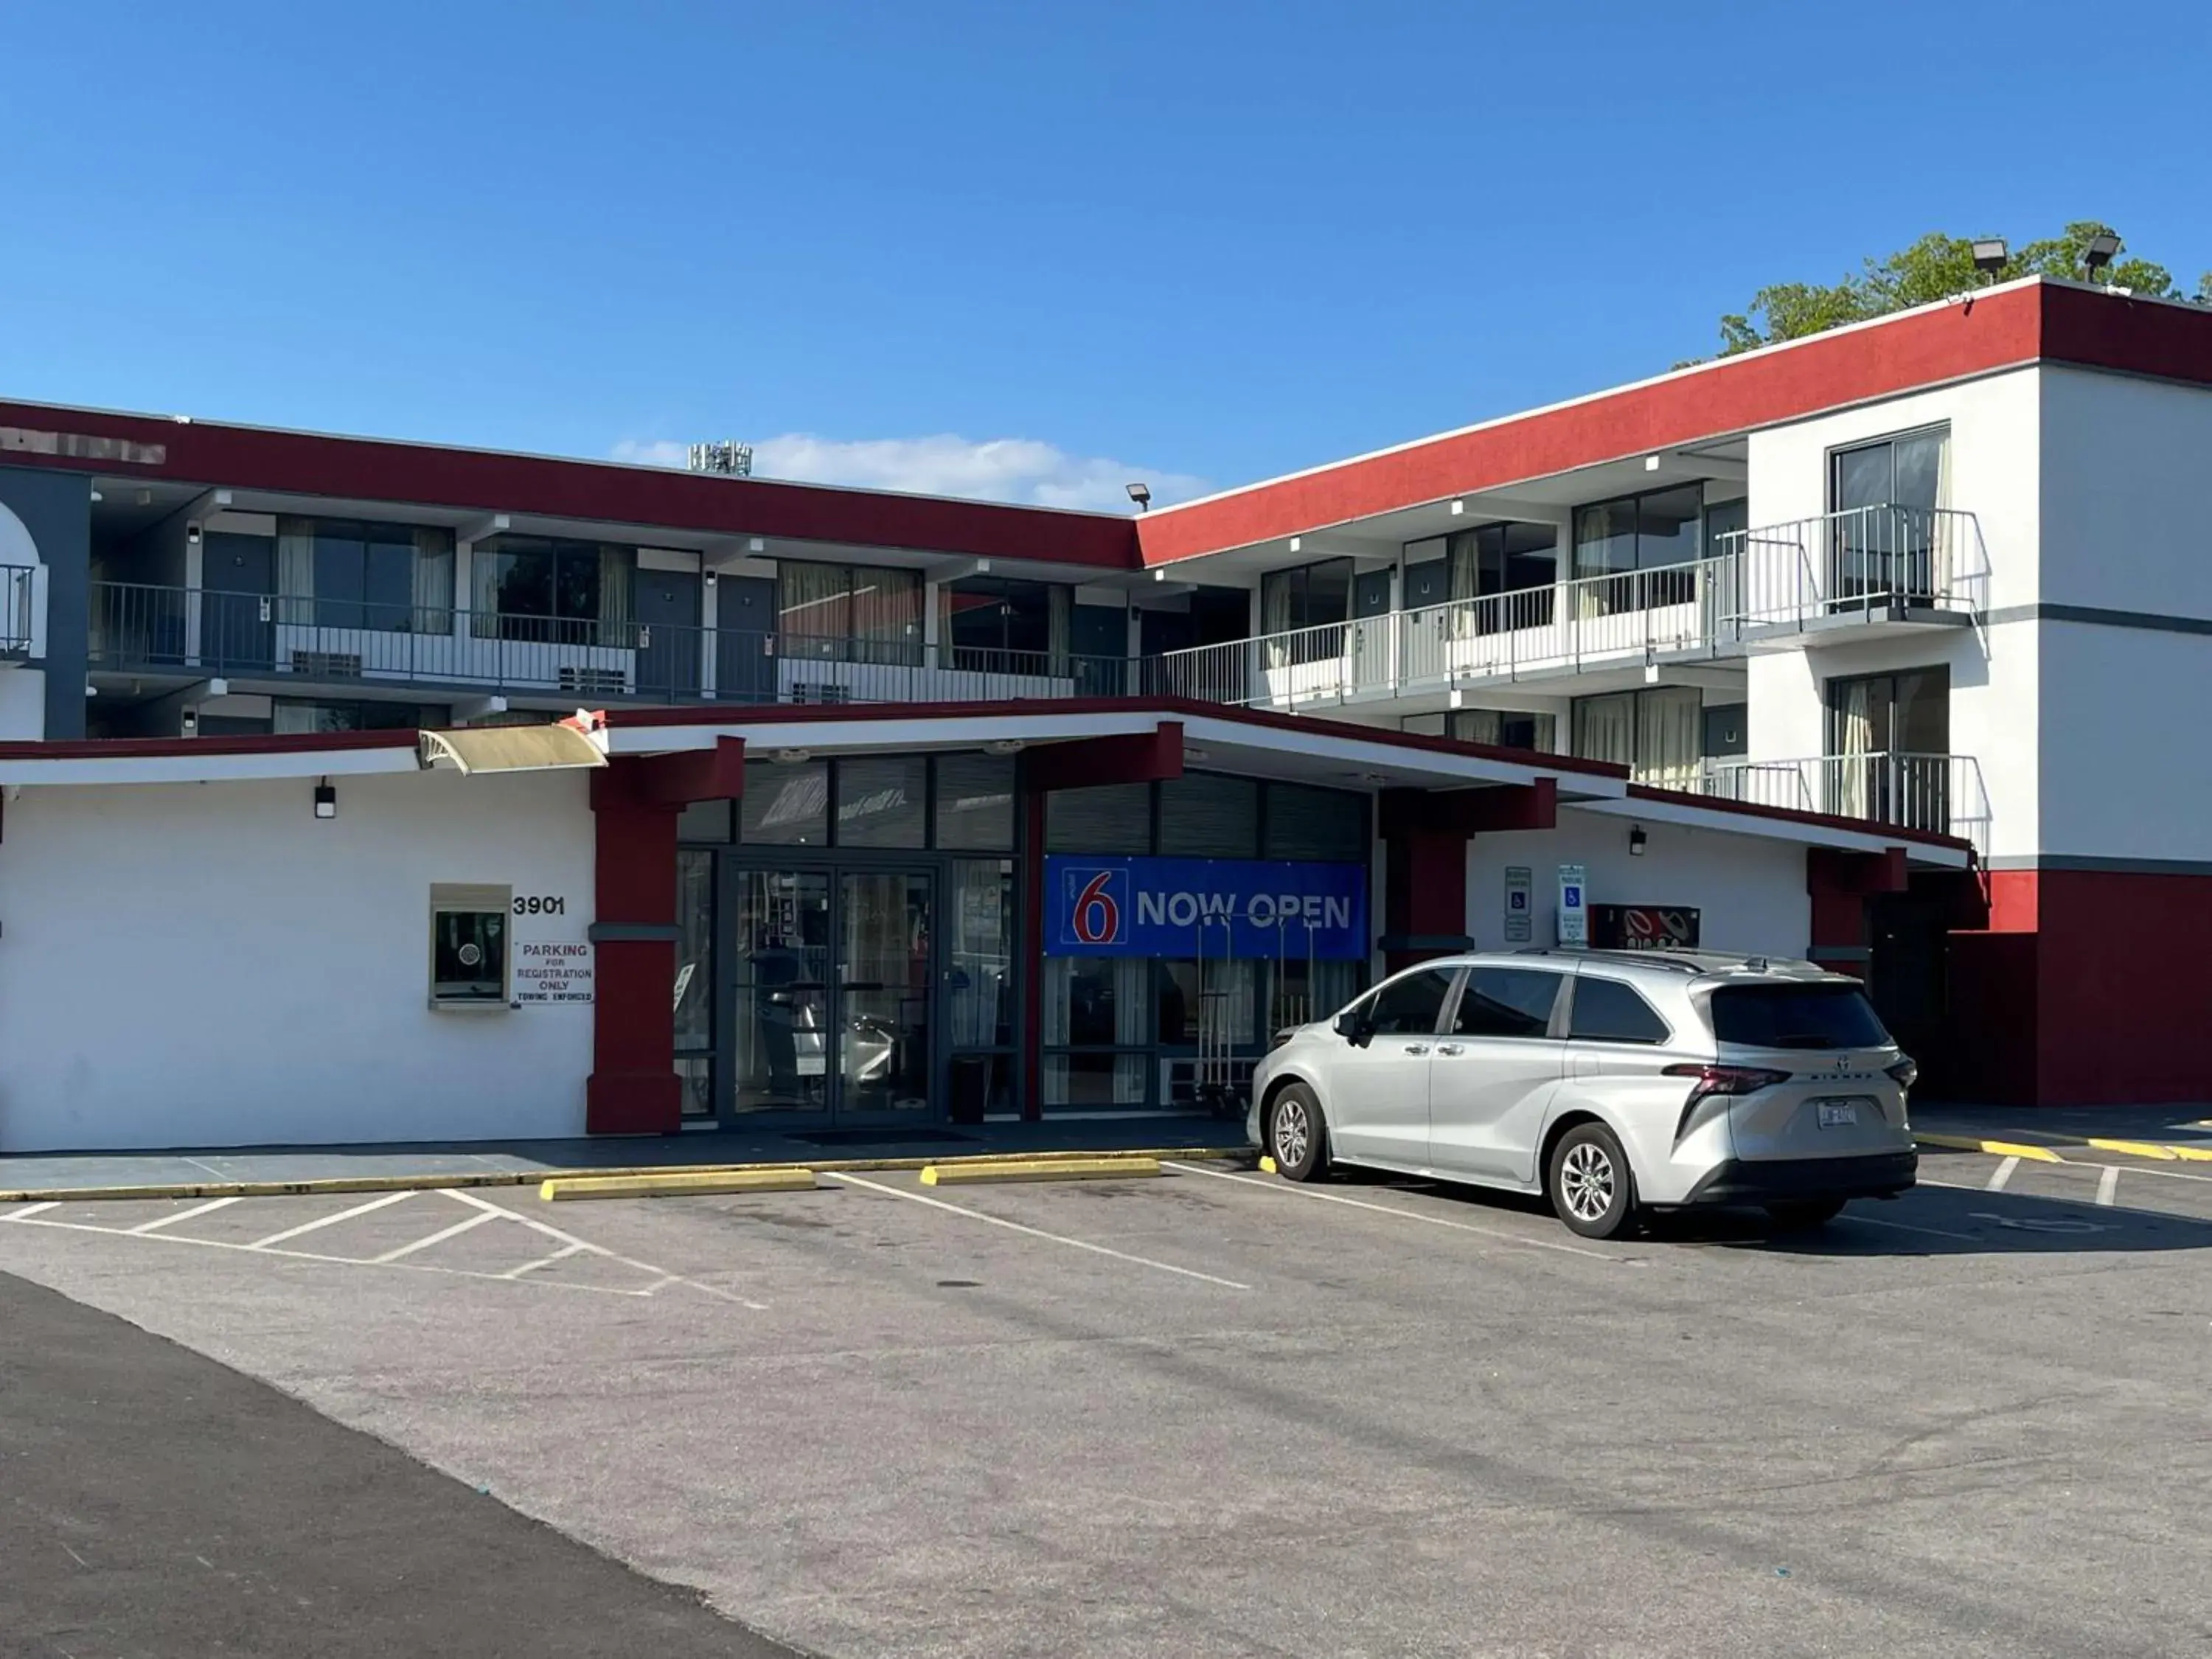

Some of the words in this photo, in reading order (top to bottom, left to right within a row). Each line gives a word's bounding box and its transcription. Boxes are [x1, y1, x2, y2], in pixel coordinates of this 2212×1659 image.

[513, 897, 565, 915] 3901
[1072, 871, 1119, 945] 6
[1137, 891, 1237, 927] NOW
[1248, 894, 1349, 929] OPEN
[523, 945, 588, 956] PARKING
[545, 958, 566, 967] FOR
[517, 969, 592, 979] REGISTRATION
[538, 981, 569, 991] ONLY
[518, 992, 548, 1001] TOWING
[552, 992, 592, 1001] ENFORCED
